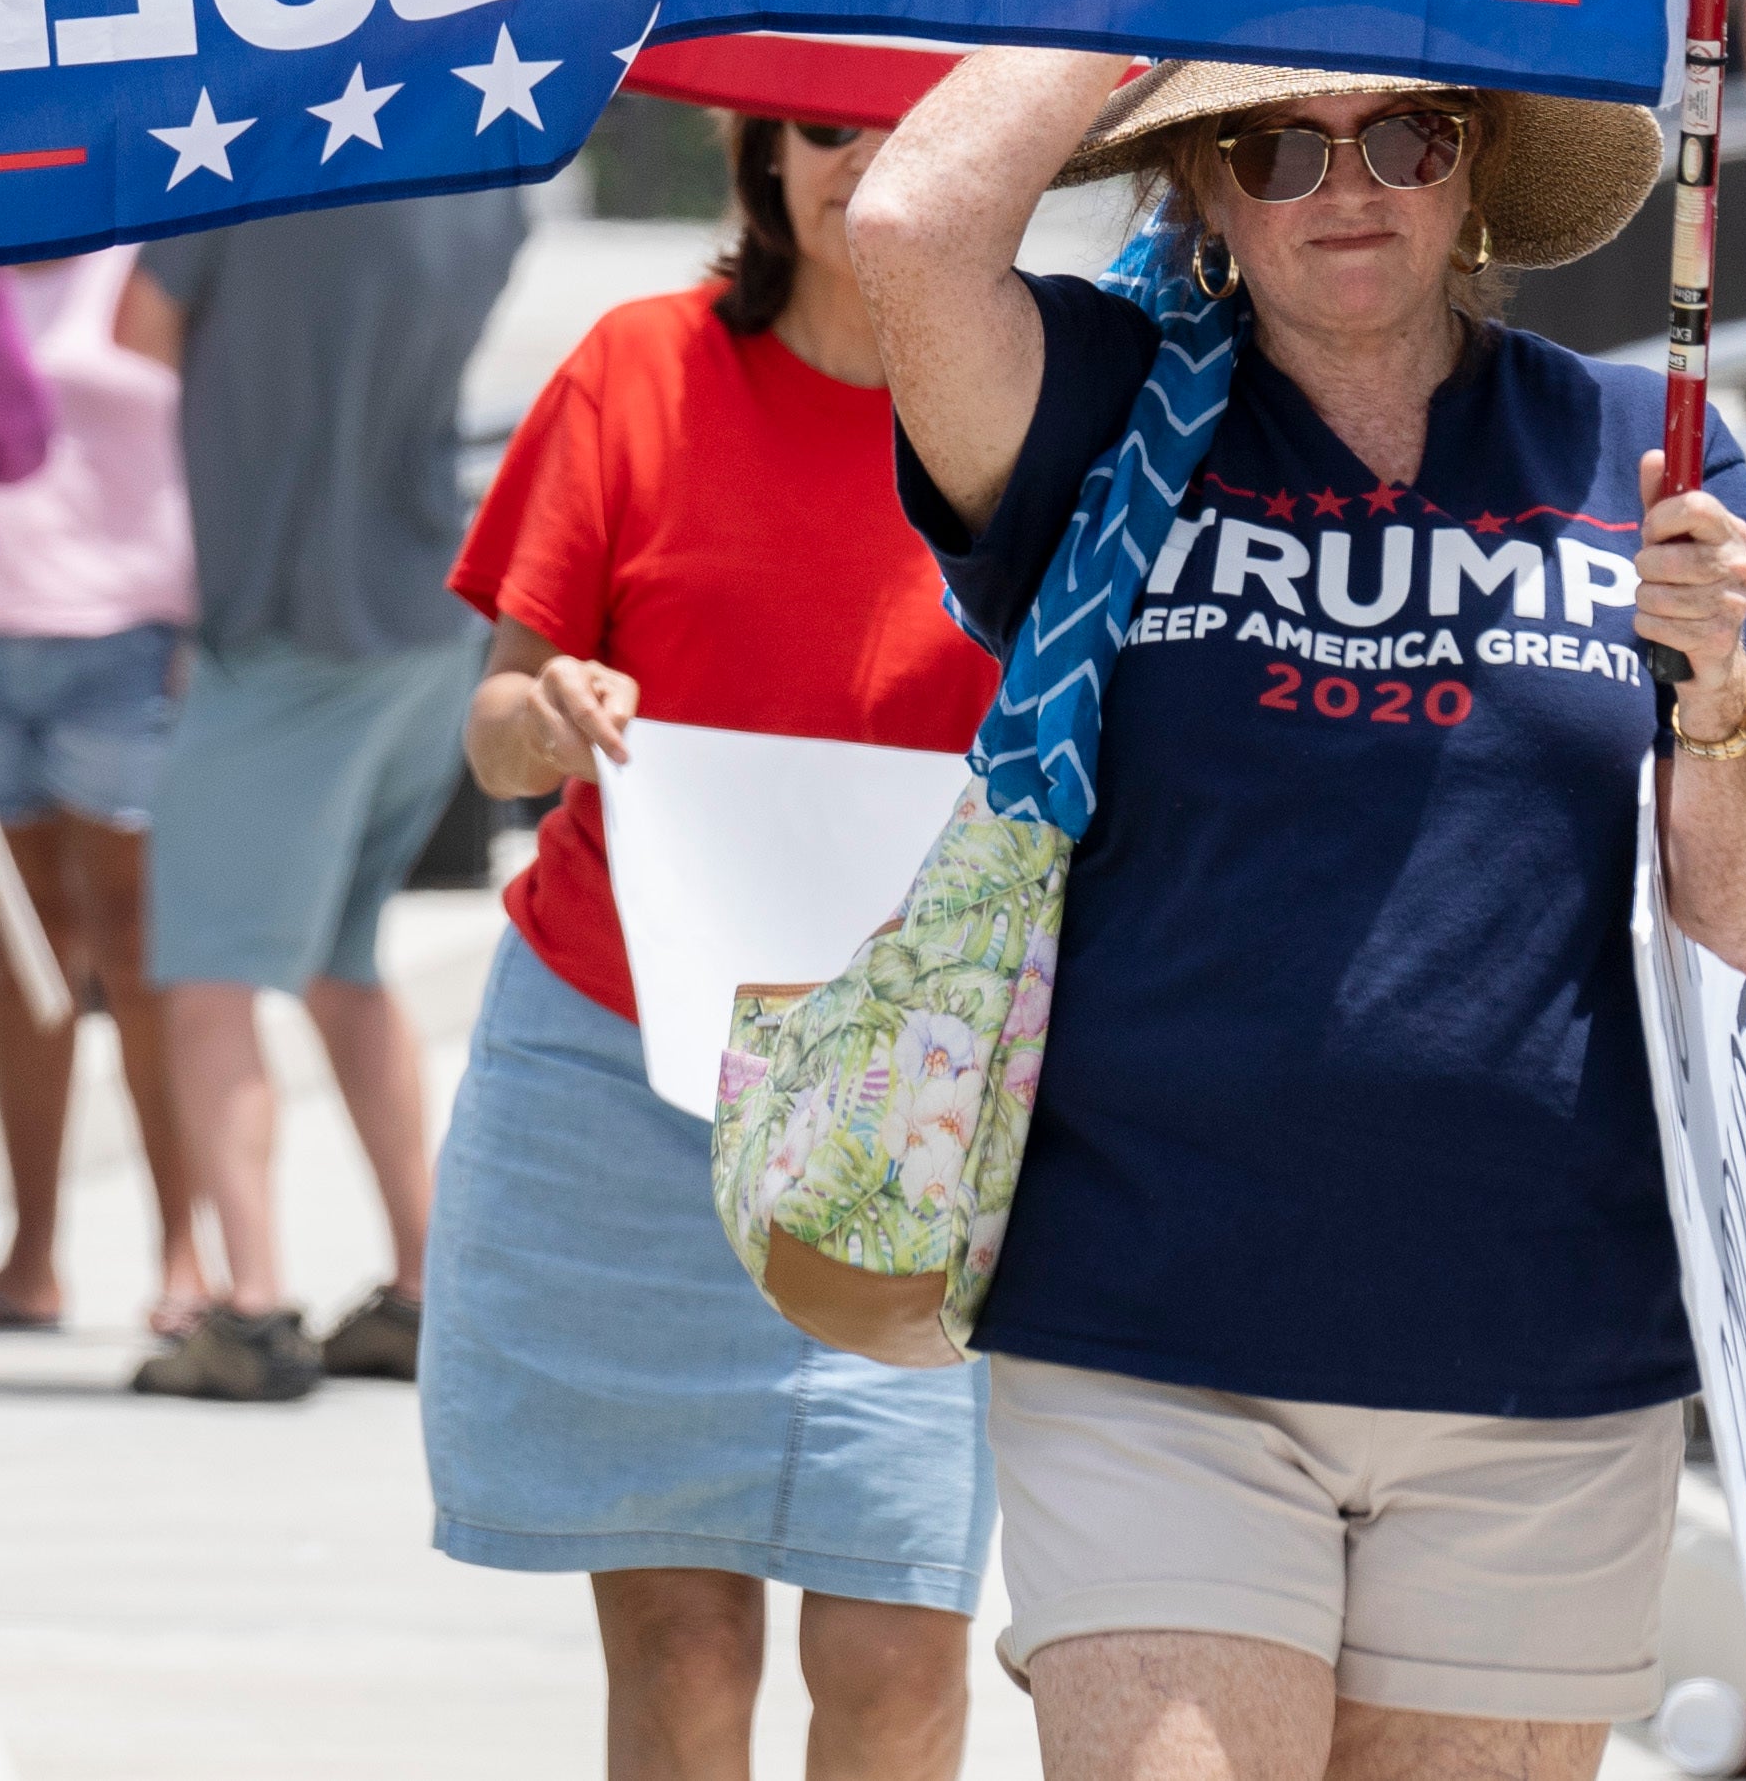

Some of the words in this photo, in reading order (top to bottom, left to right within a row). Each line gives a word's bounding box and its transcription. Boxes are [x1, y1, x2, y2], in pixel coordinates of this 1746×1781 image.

[1146, 507, 1643, 628] TRUMP
[1235, 611, 1464, 671] AMERICA
[1475, 627, 1641, 687] GREAT!
[1258, 661, 1473, 727] 2020
